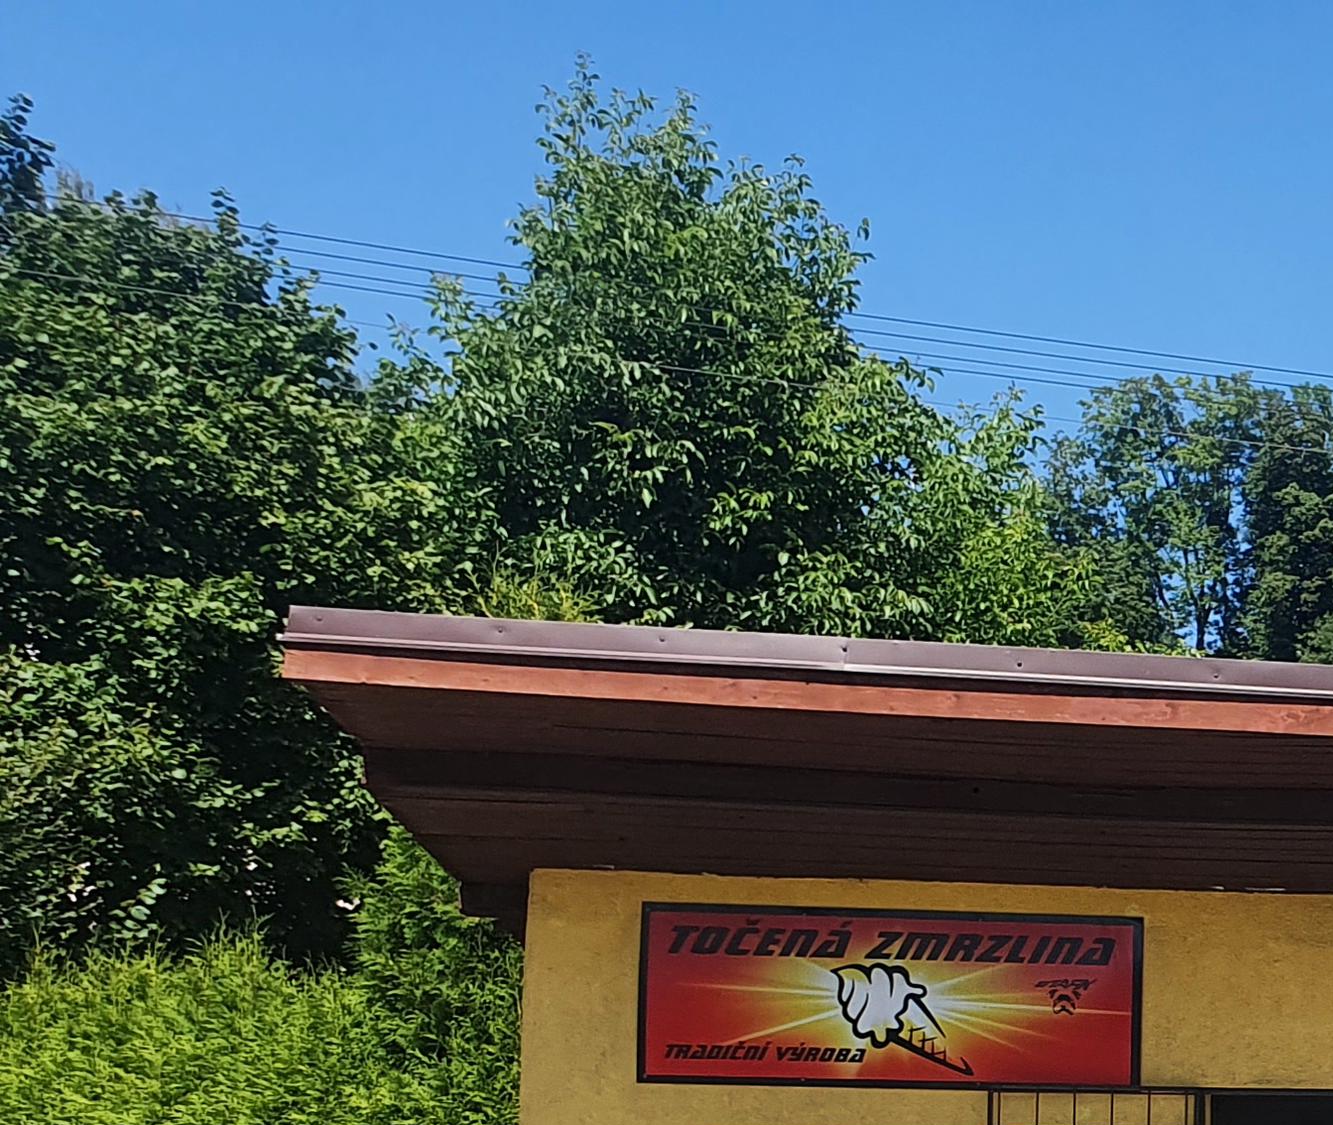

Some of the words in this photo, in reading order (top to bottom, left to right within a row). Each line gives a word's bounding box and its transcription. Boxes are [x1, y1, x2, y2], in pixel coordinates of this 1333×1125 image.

[667, 919, 852, 959] TOČENÁ
[864, 931, 1117, 966] ZMRZLINA
[664, 1041, 771, 1061] TRADIČNÍ
[776, 1042, 867, 1063] VÝROBA
